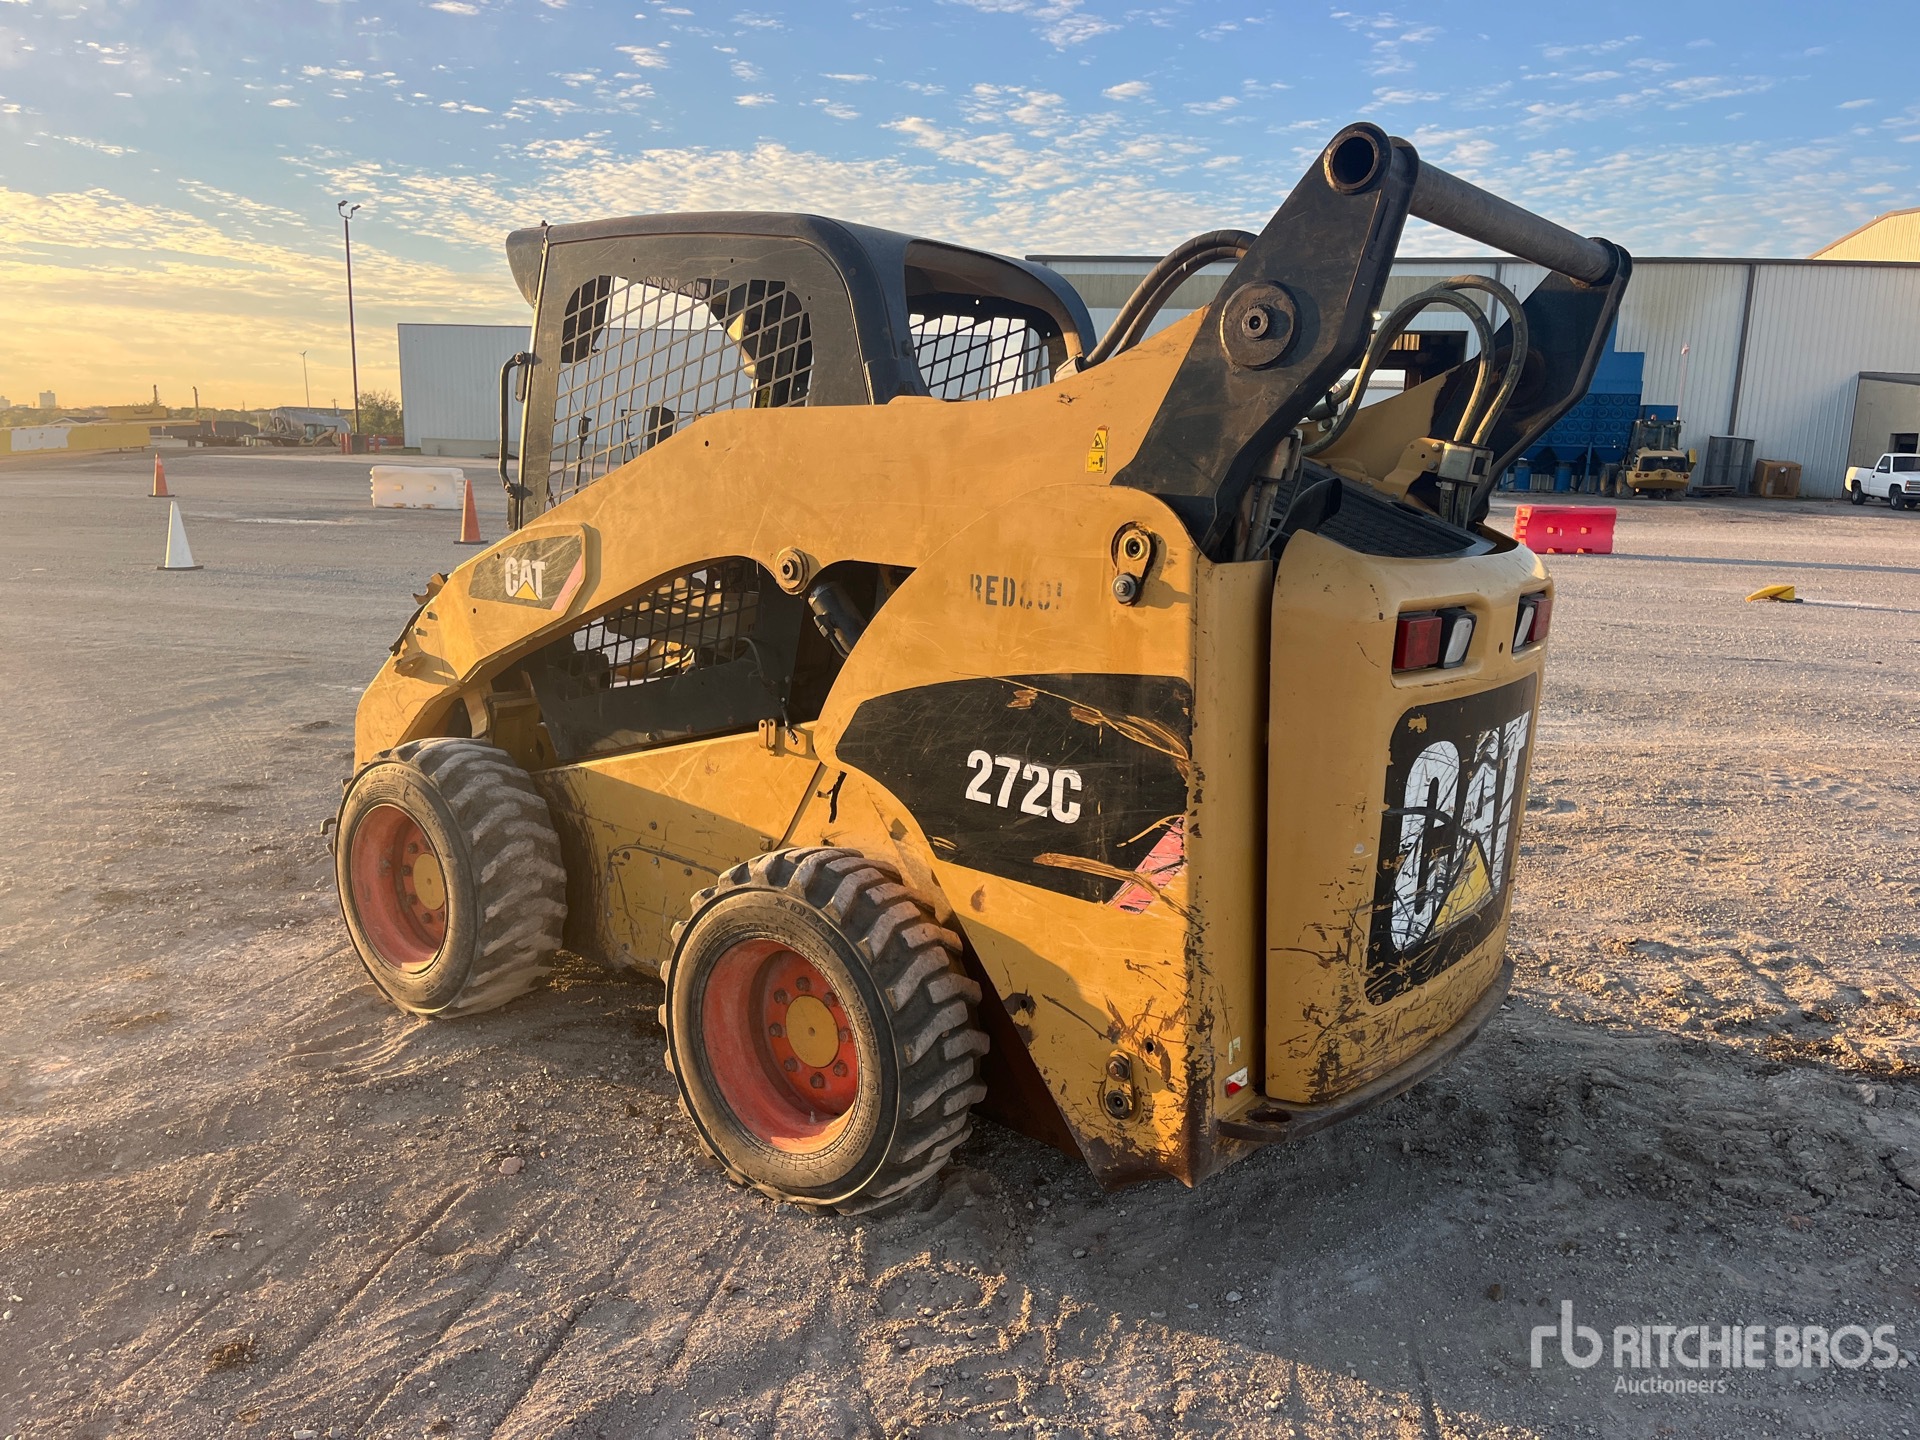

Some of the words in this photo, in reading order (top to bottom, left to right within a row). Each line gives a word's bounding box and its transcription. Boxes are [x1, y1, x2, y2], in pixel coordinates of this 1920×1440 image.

[505, 557, 546, 601] CAT
[965, 749, 1083, 824] 272C
[1391, 711, 1531, 951] CAT
